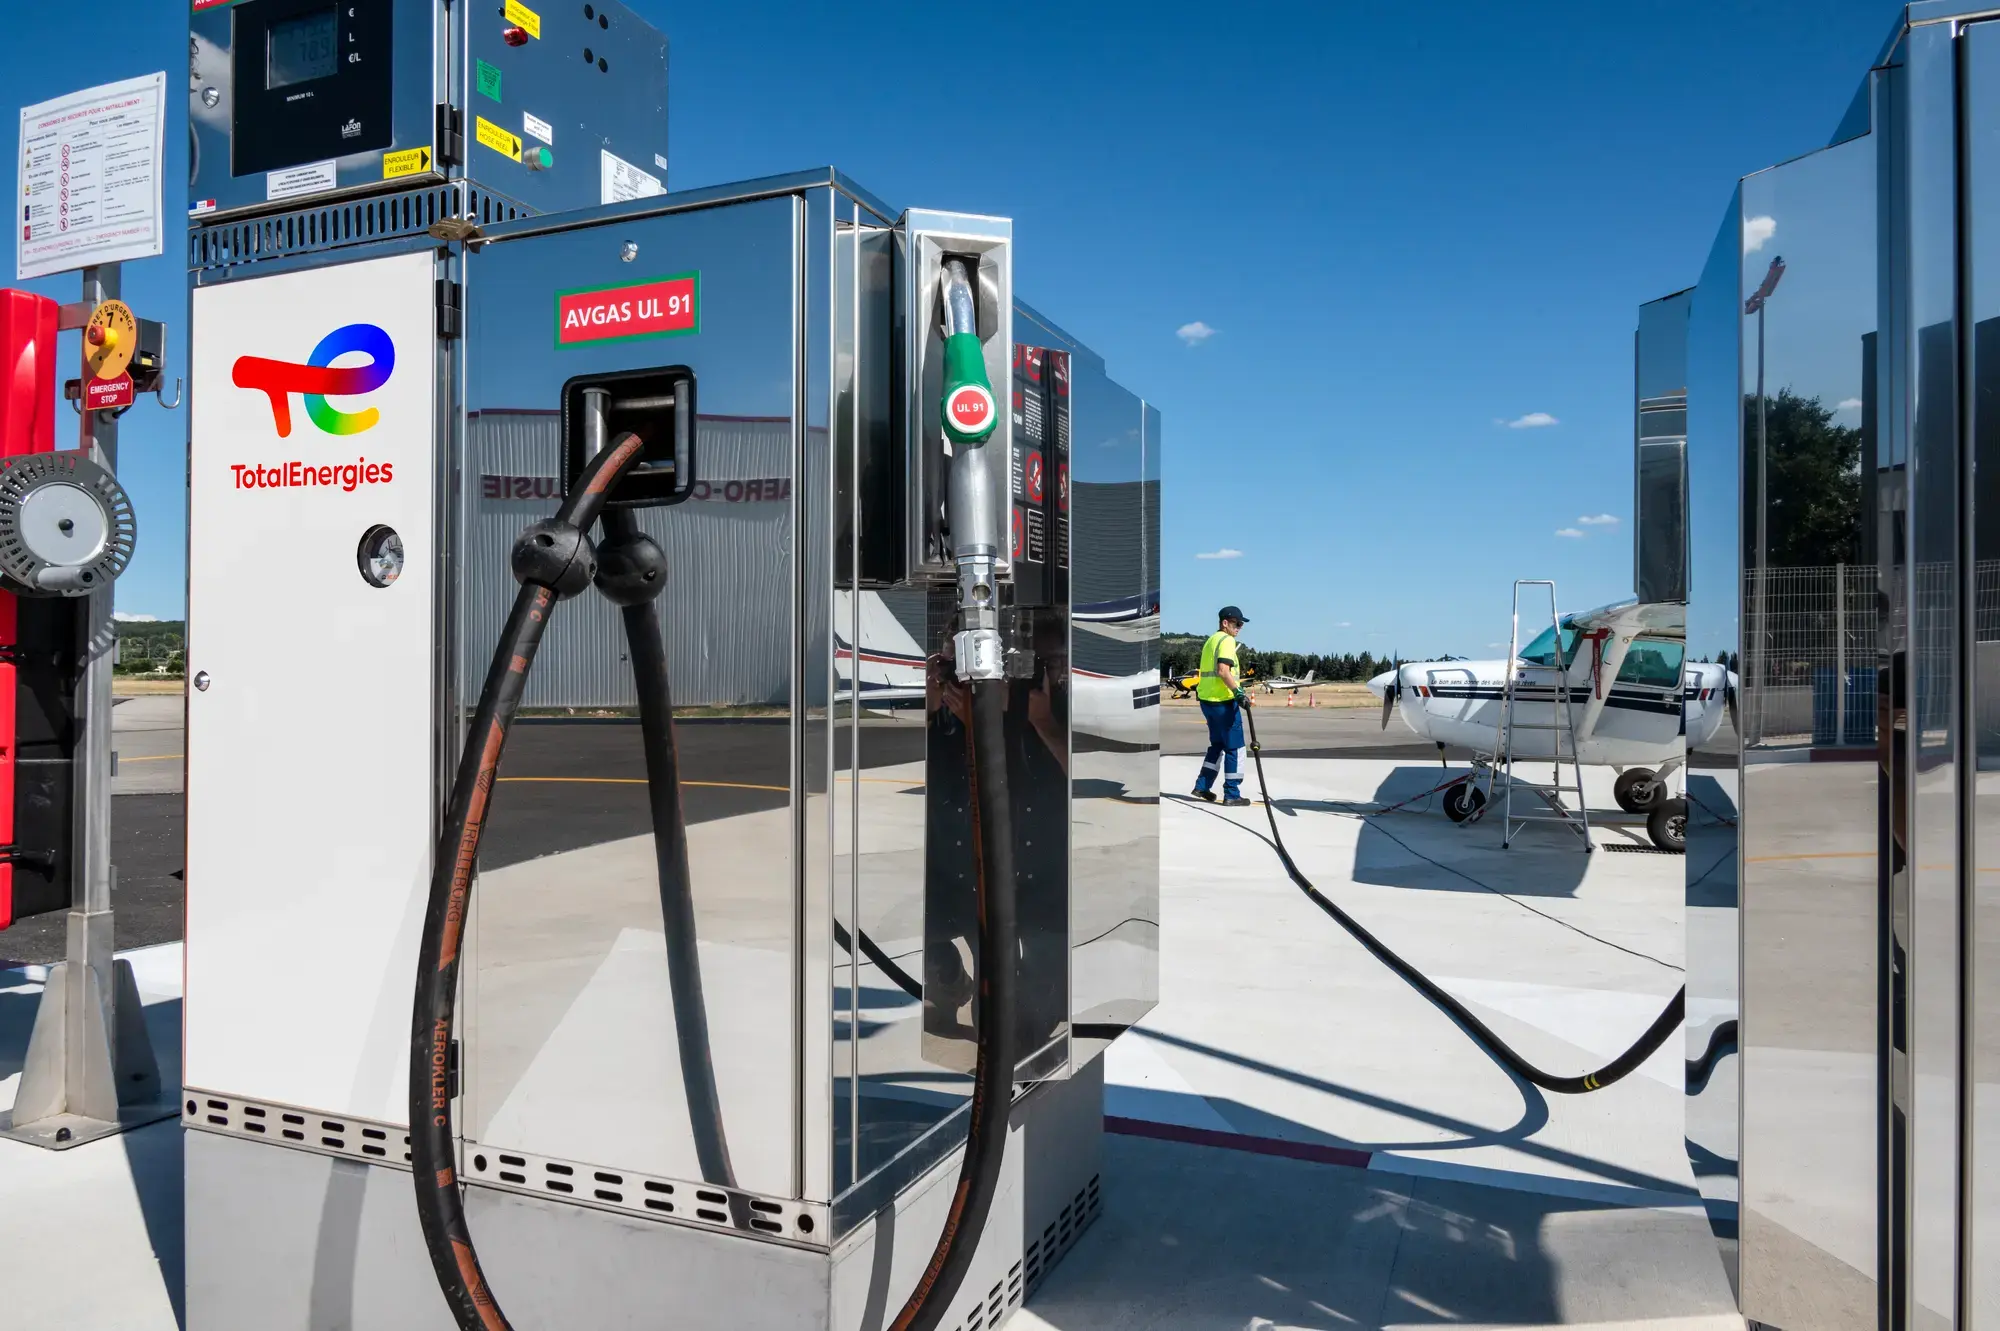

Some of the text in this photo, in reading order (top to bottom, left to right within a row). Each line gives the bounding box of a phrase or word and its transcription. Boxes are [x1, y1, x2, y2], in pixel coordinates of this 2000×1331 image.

[348, 32, 355, 42] L
[286, 93, 305, 101] MINIMUM
[478, 122, 511, 142] ENROULEUR
[385, 153, 419, 165] ENROULEUR
[389, 163, 414, 173] FLEXIBLE
[565, 294, 690, 328] AVGAS UL 91
[106, 312, 114, 328] 7
[90, 381, 129, 394] EMERGENCY
[101, 394, 117, 404] STOP
[957, 402, 984, 412] UL 91
[231, 457, 393, 492] TotalEnergies
[530, 610, 542, 622] C
[448, 820, 479, 922] TRELLEBORG
[432, 1018, 449, 1126] AEROKLER C
